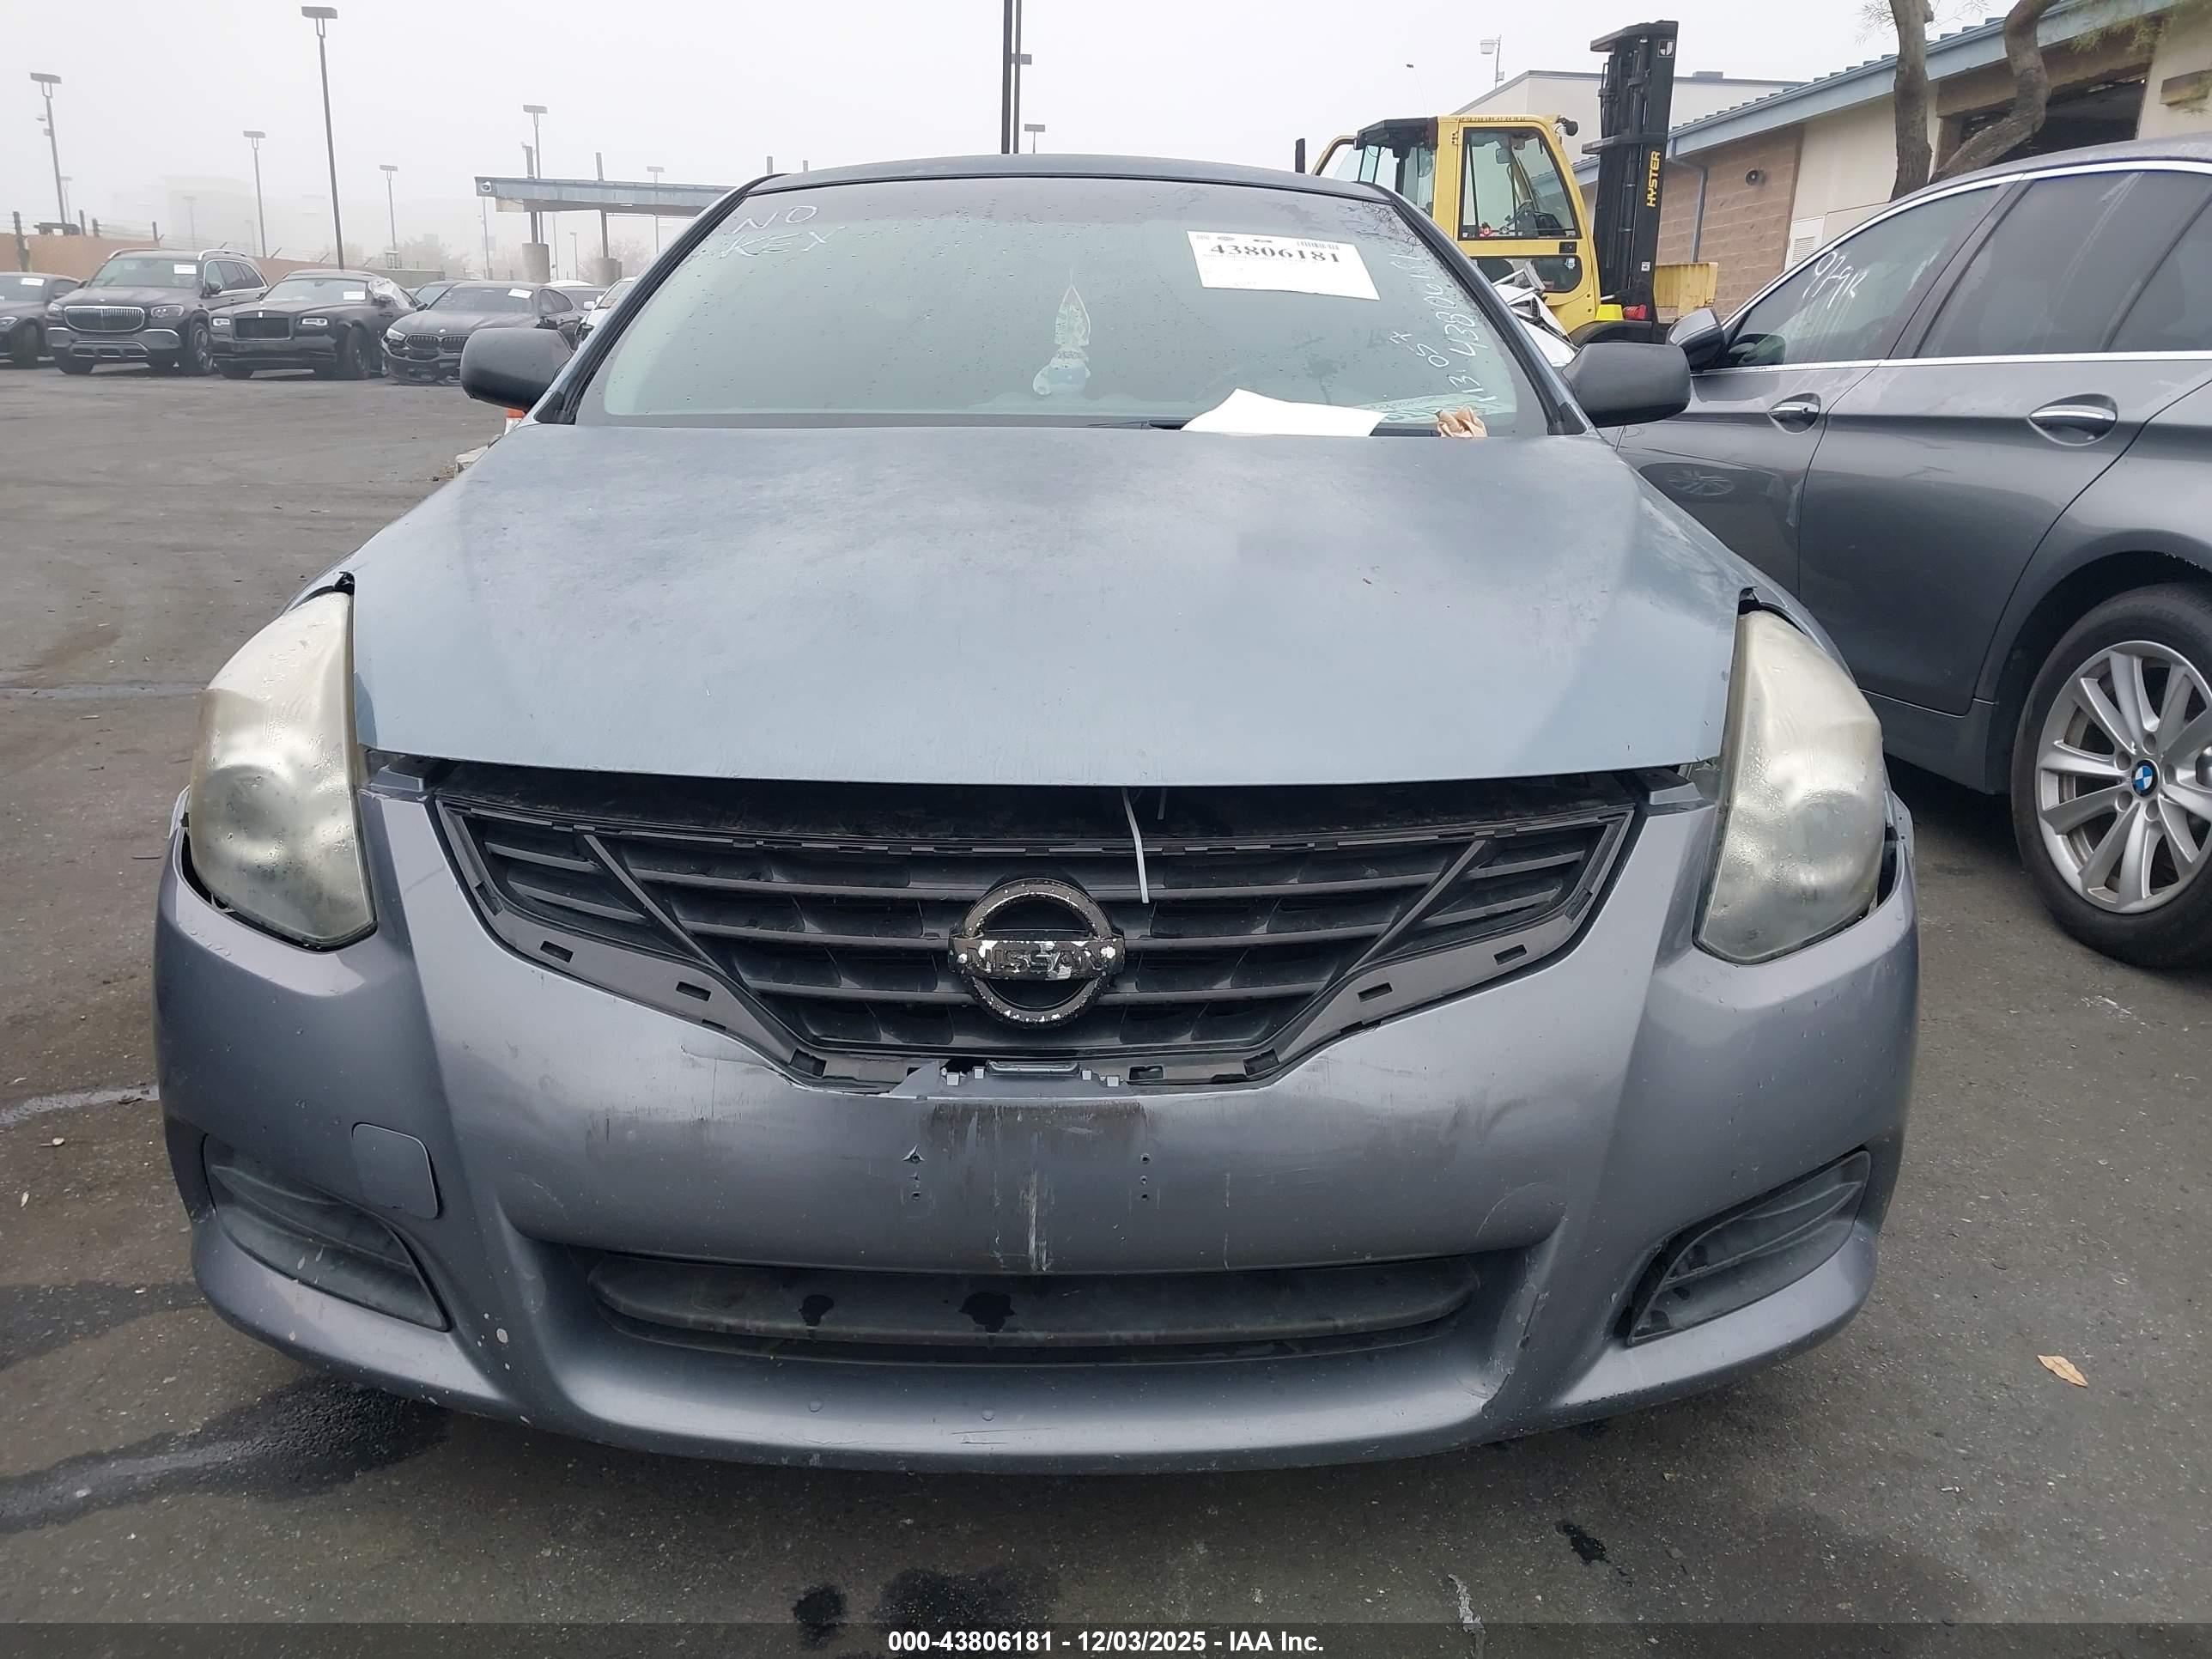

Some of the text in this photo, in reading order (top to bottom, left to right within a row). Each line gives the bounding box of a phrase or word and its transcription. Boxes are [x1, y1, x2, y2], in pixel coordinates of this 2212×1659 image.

[1646, 150, 1661, 208] HYSTER
[732, 205, 819, 234] NO
[1210, 243, 1340, 264] 43806181
[966, 946, 1104, 974] NISSAN
